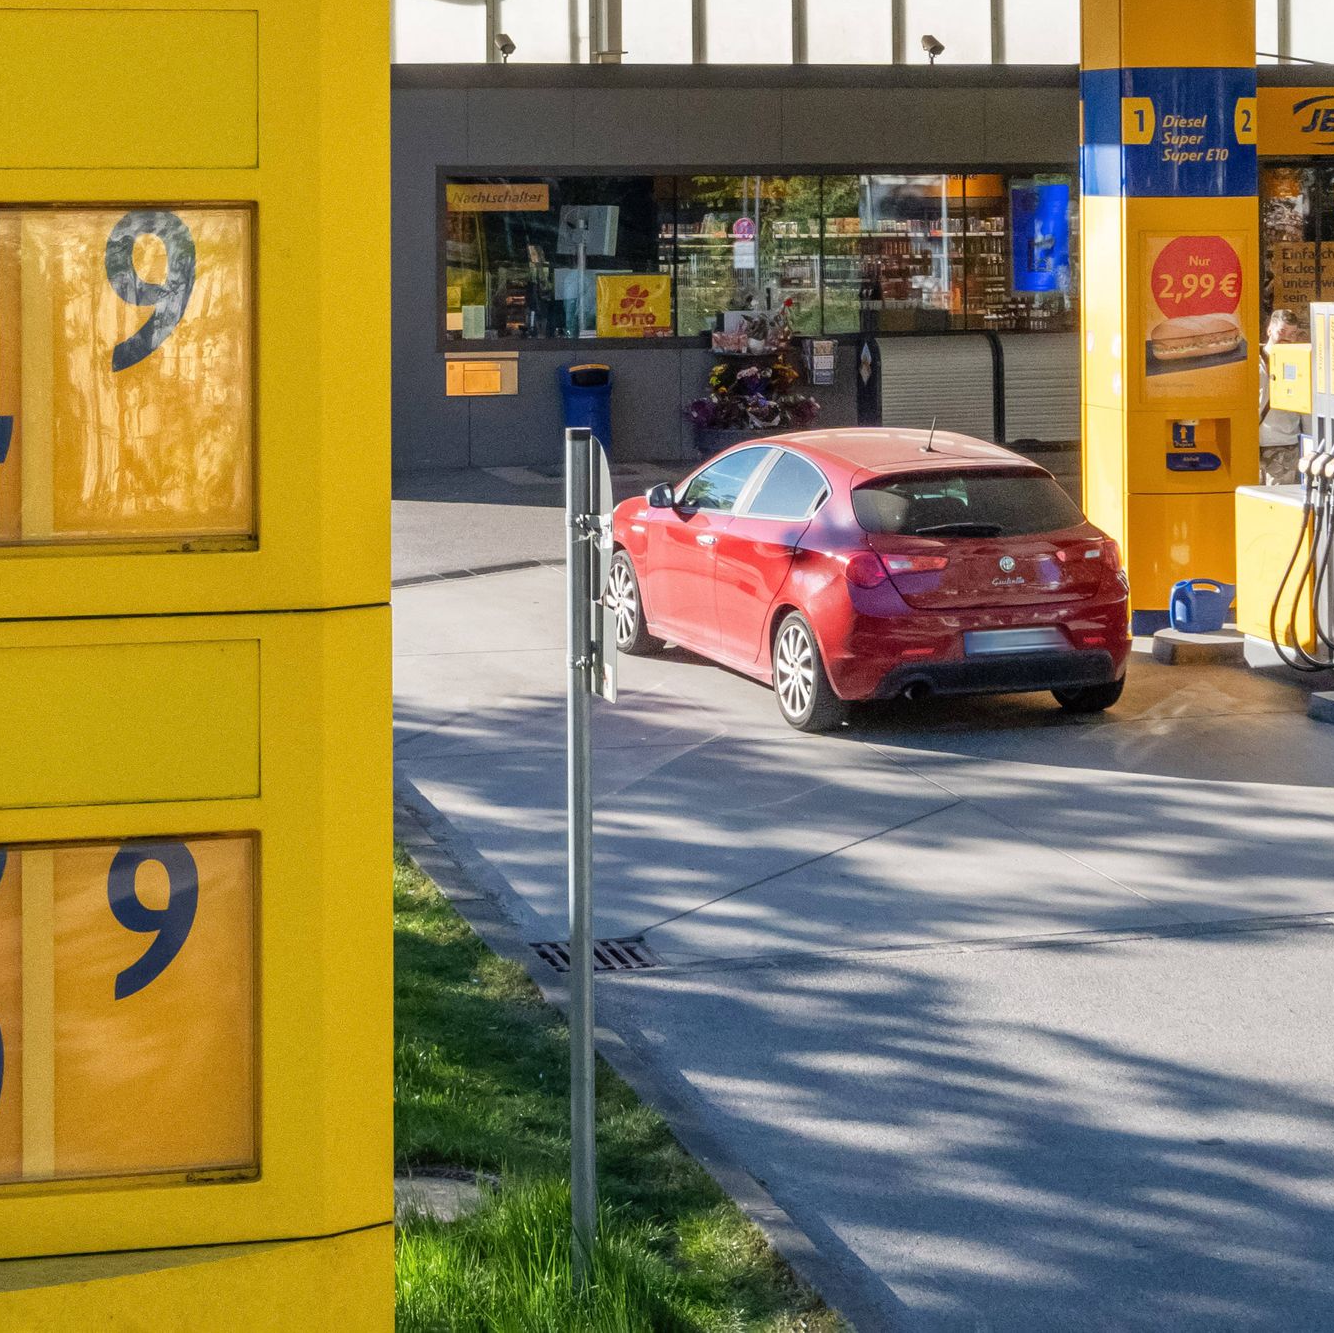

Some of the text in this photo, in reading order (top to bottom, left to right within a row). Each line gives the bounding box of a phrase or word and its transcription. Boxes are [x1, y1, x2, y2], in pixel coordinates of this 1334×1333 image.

[1134, 110, 1144, 132] 1
[1162, 115, 1207, 128] Diesel
[1241, 109, 1251, 132] 2
[1162, 132, 1204, 148] Super
[1162, 148, 1229, 165] Super E10
[452, 191, 544, 204] Nachtschalter
[1189, 255, 1211, 266] Nur
[1282, 247, 1334, 260] Einfach
[103, 209, 196, 372] 9
[611, 313, 655, 326] LOTTO
[106, 842, 200, 1000] 9
